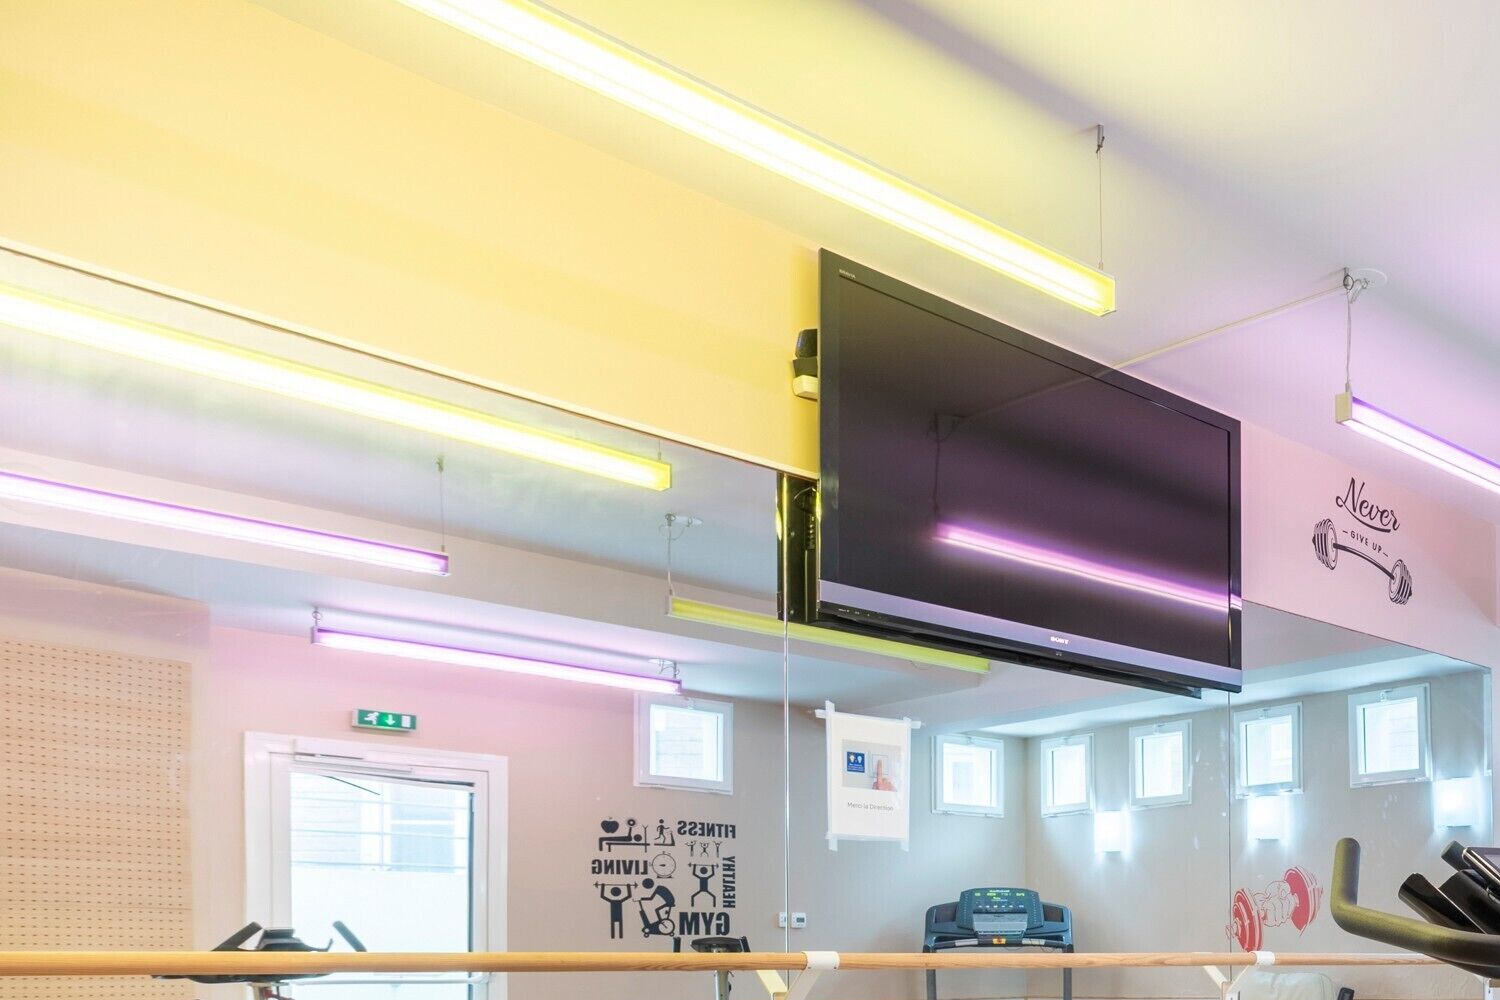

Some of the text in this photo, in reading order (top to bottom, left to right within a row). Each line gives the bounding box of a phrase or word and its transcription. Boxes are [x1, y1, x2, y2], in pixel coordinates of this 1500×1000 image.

[1336, 477, 1400, 532] Never
[1350, 530, 1382, 553] GIVE UP
